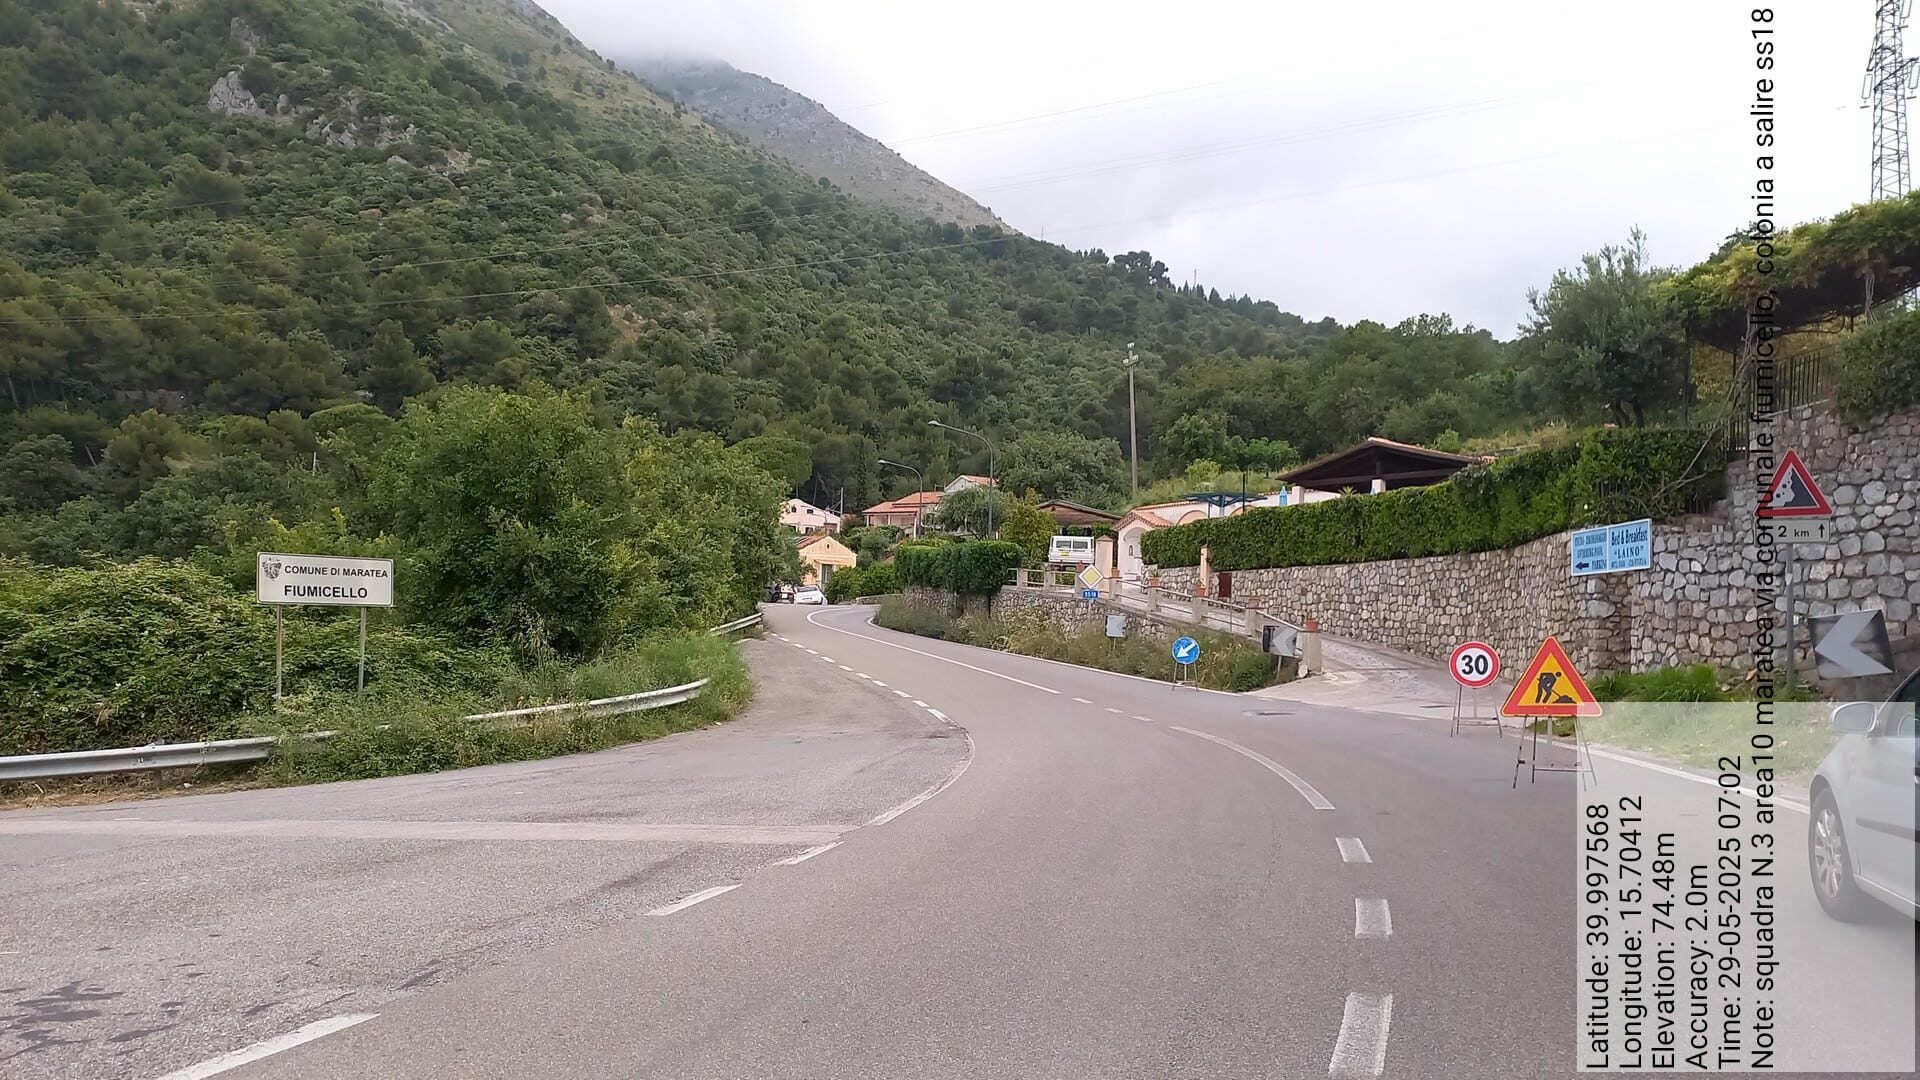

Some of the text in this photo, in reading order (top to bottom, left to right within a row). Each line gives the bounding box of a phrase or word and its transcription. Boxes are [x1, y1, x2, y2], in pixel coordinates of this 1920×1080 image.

[1612, 531, 1621, 546] Bed
[1621, 530, 1625, 545] &
[1626, 526, 1648, 544] Breakfast
[1777, 525, 1810, 538] 2 km
[284, 565, 388, 578] COMUNE DI MARATEA
[284, 585, 368, 598] FIUMICELLO
[1461, 654, 1489, 676] 30
